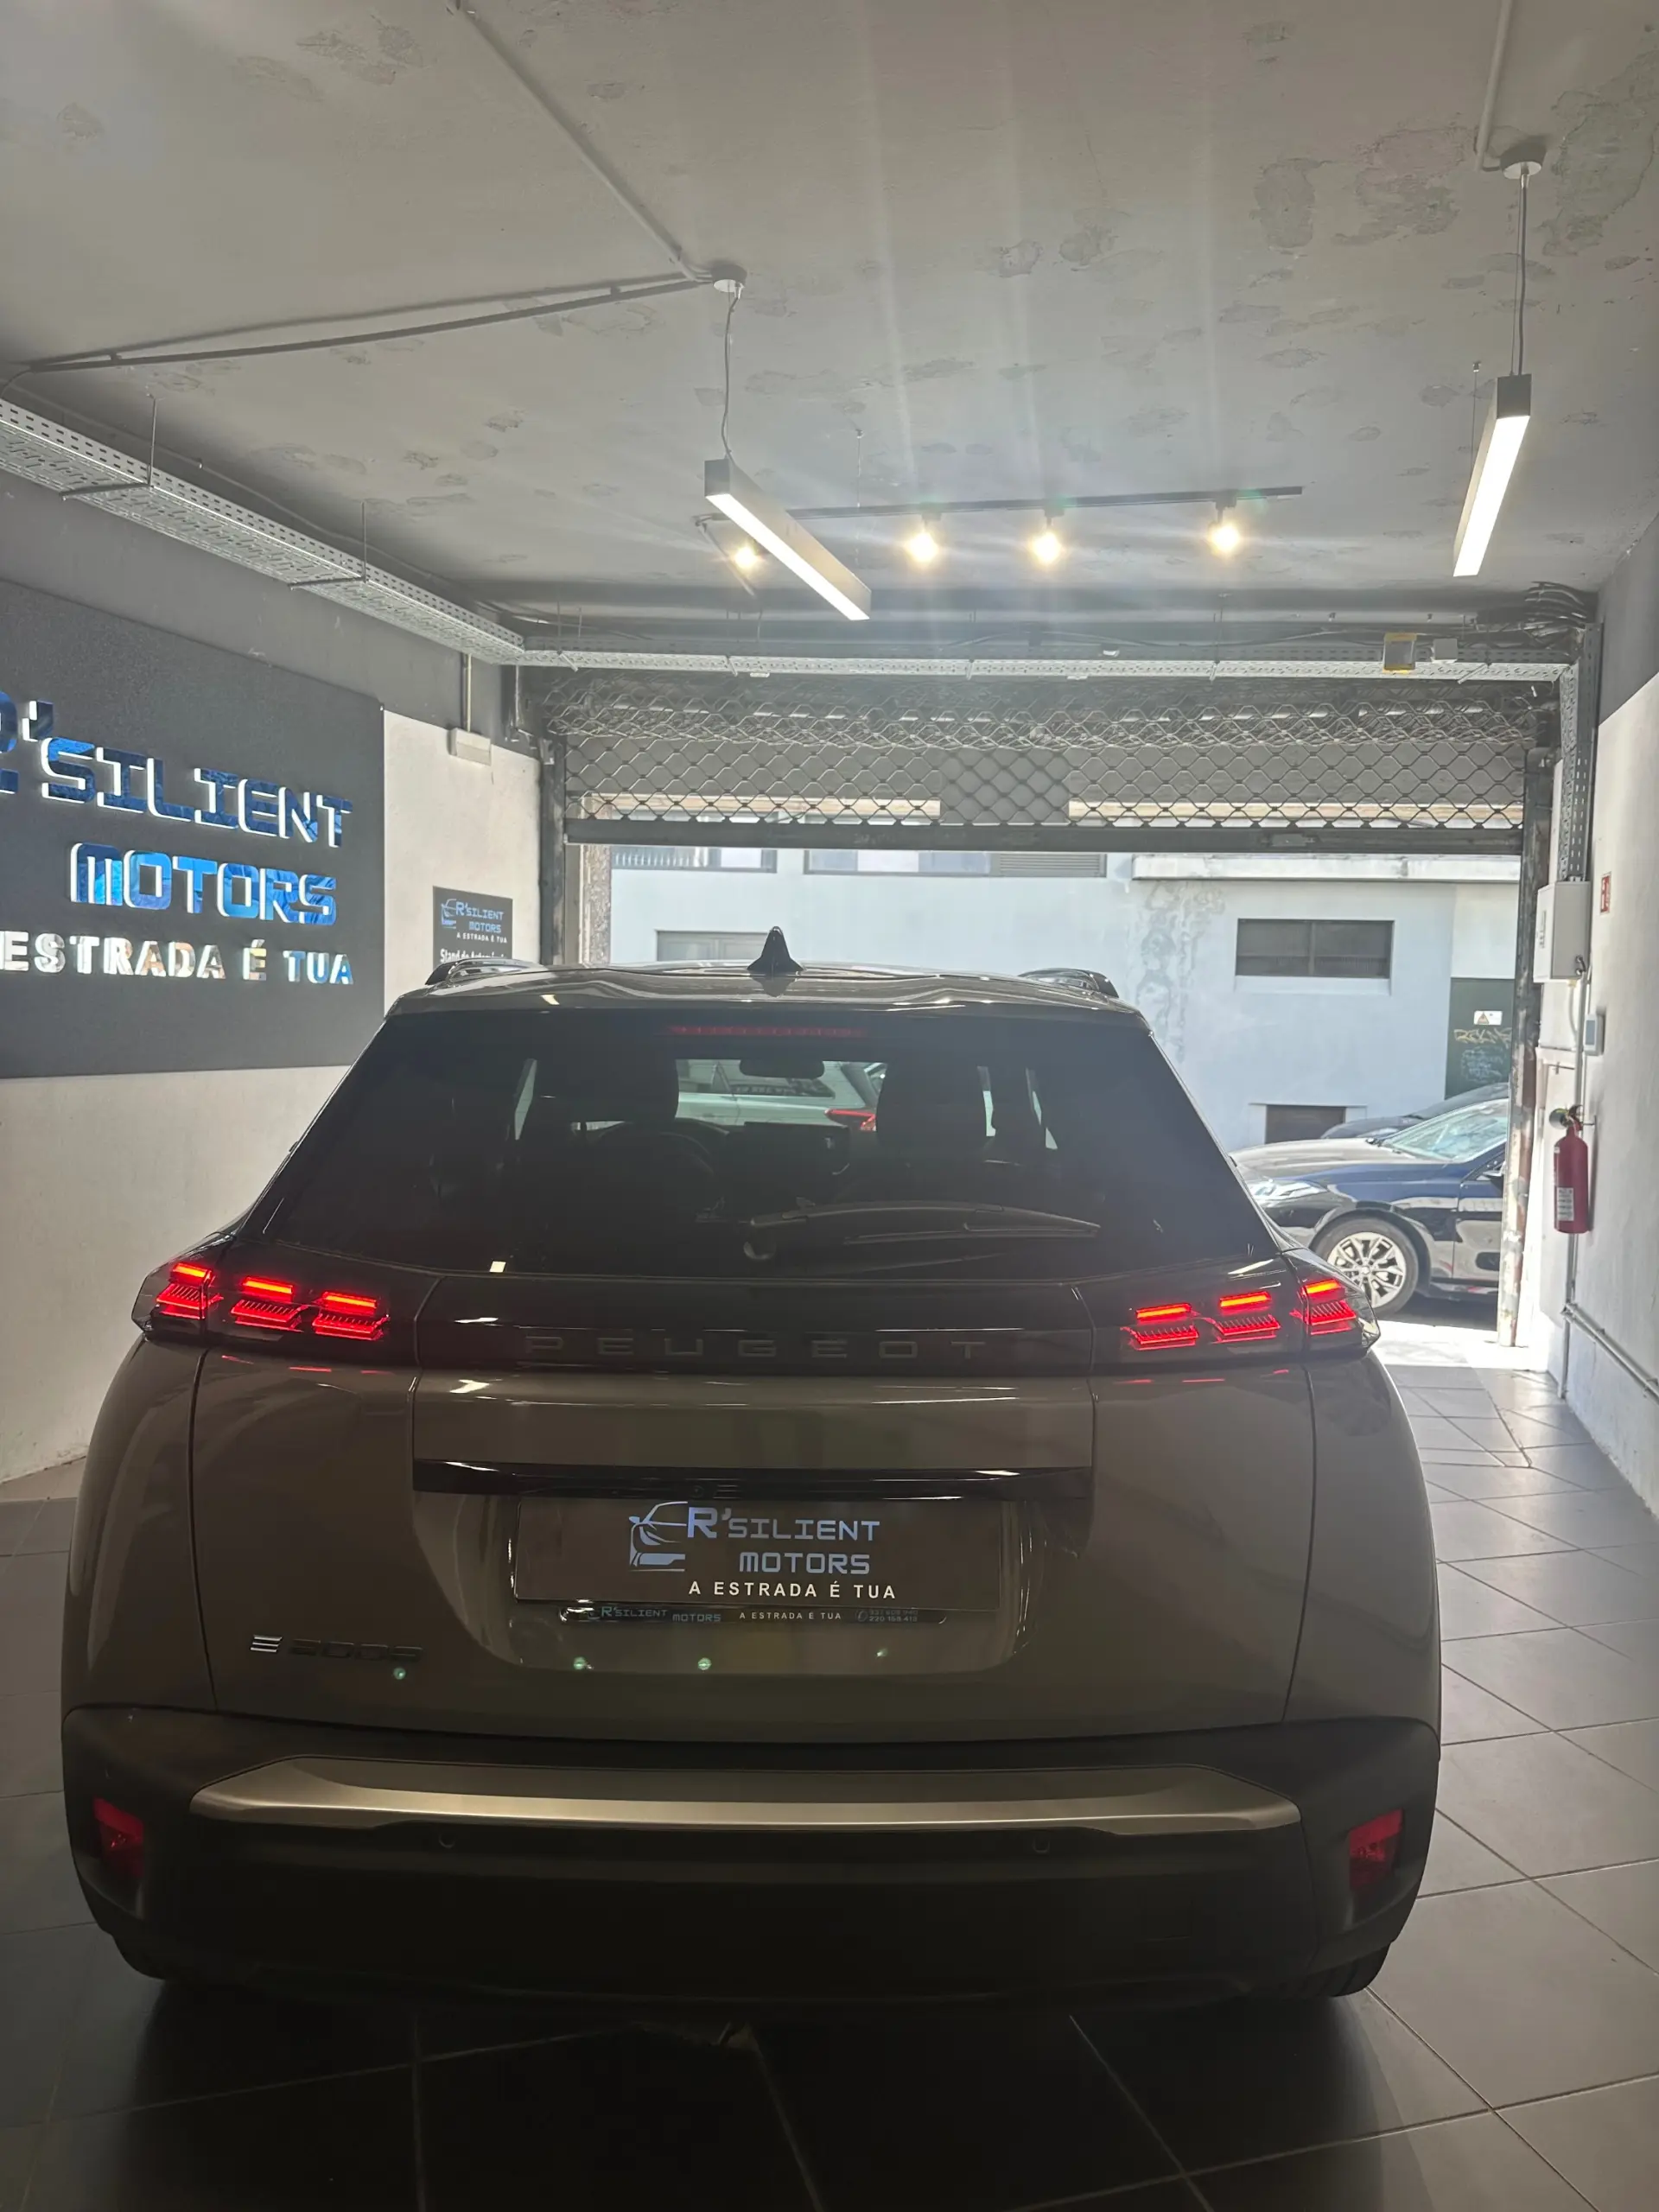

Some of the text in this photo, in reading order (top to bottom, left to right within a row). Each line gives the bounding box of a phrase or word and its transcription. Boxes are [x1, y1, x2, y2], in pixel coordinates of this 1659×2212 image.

[0, 690, 353, 848] 'SILIENT
[70, 842, 337, 926] MOTORS
[456, 901, 504, 920] R'SILIENT
[462, 933, 489, 942] ESTRADA
[469, 921, 501, 934] MOTORS
[0, 931, 353, 985] ESTRADA É TUA
[525, 1335, 987, 1361] PEUGEOT
[688, 1507, 880, 1541] R'SILIENT
[740, 1552, 870, 1574] MOTORS
[689, 1580, 895, 1599] A ESTRADA É TUA
[601, 1606, 668, 1618] R'SILIENT
[672, 1613, 721, 1623] MOTORS
